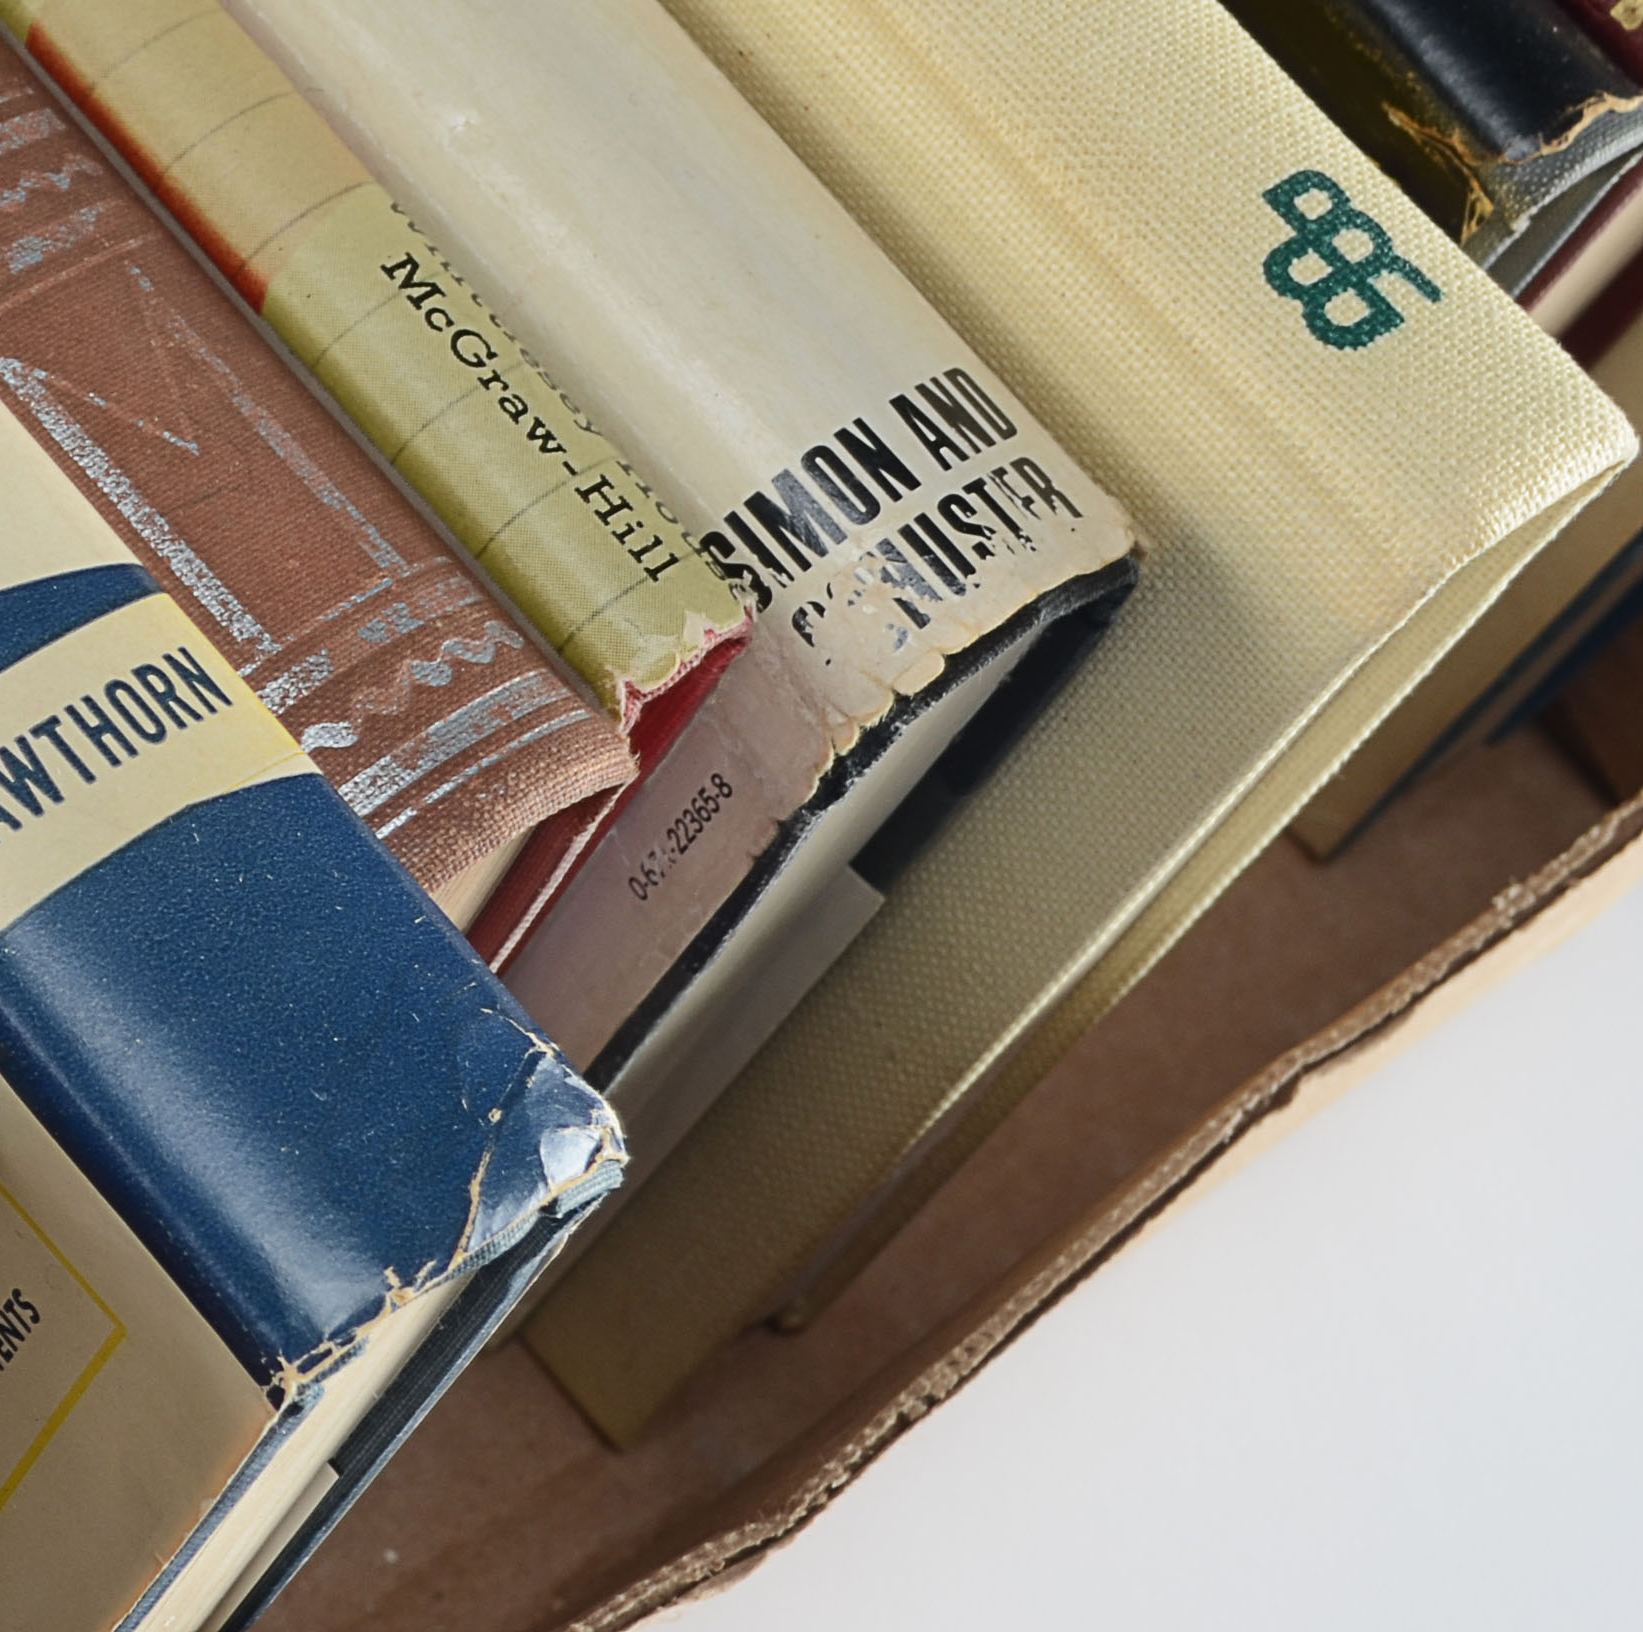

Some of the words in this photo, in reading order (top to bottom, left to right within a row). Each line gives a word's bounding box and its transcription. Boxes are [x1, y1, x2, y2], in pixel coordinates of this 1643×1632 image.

[380, 252, 680, 582] McGraw-Hill
[699, 417, 922, 613] SIMON
[888, 367, 1018, 471] AND
[628, 773, 733, 901] 0-6-22365-8
